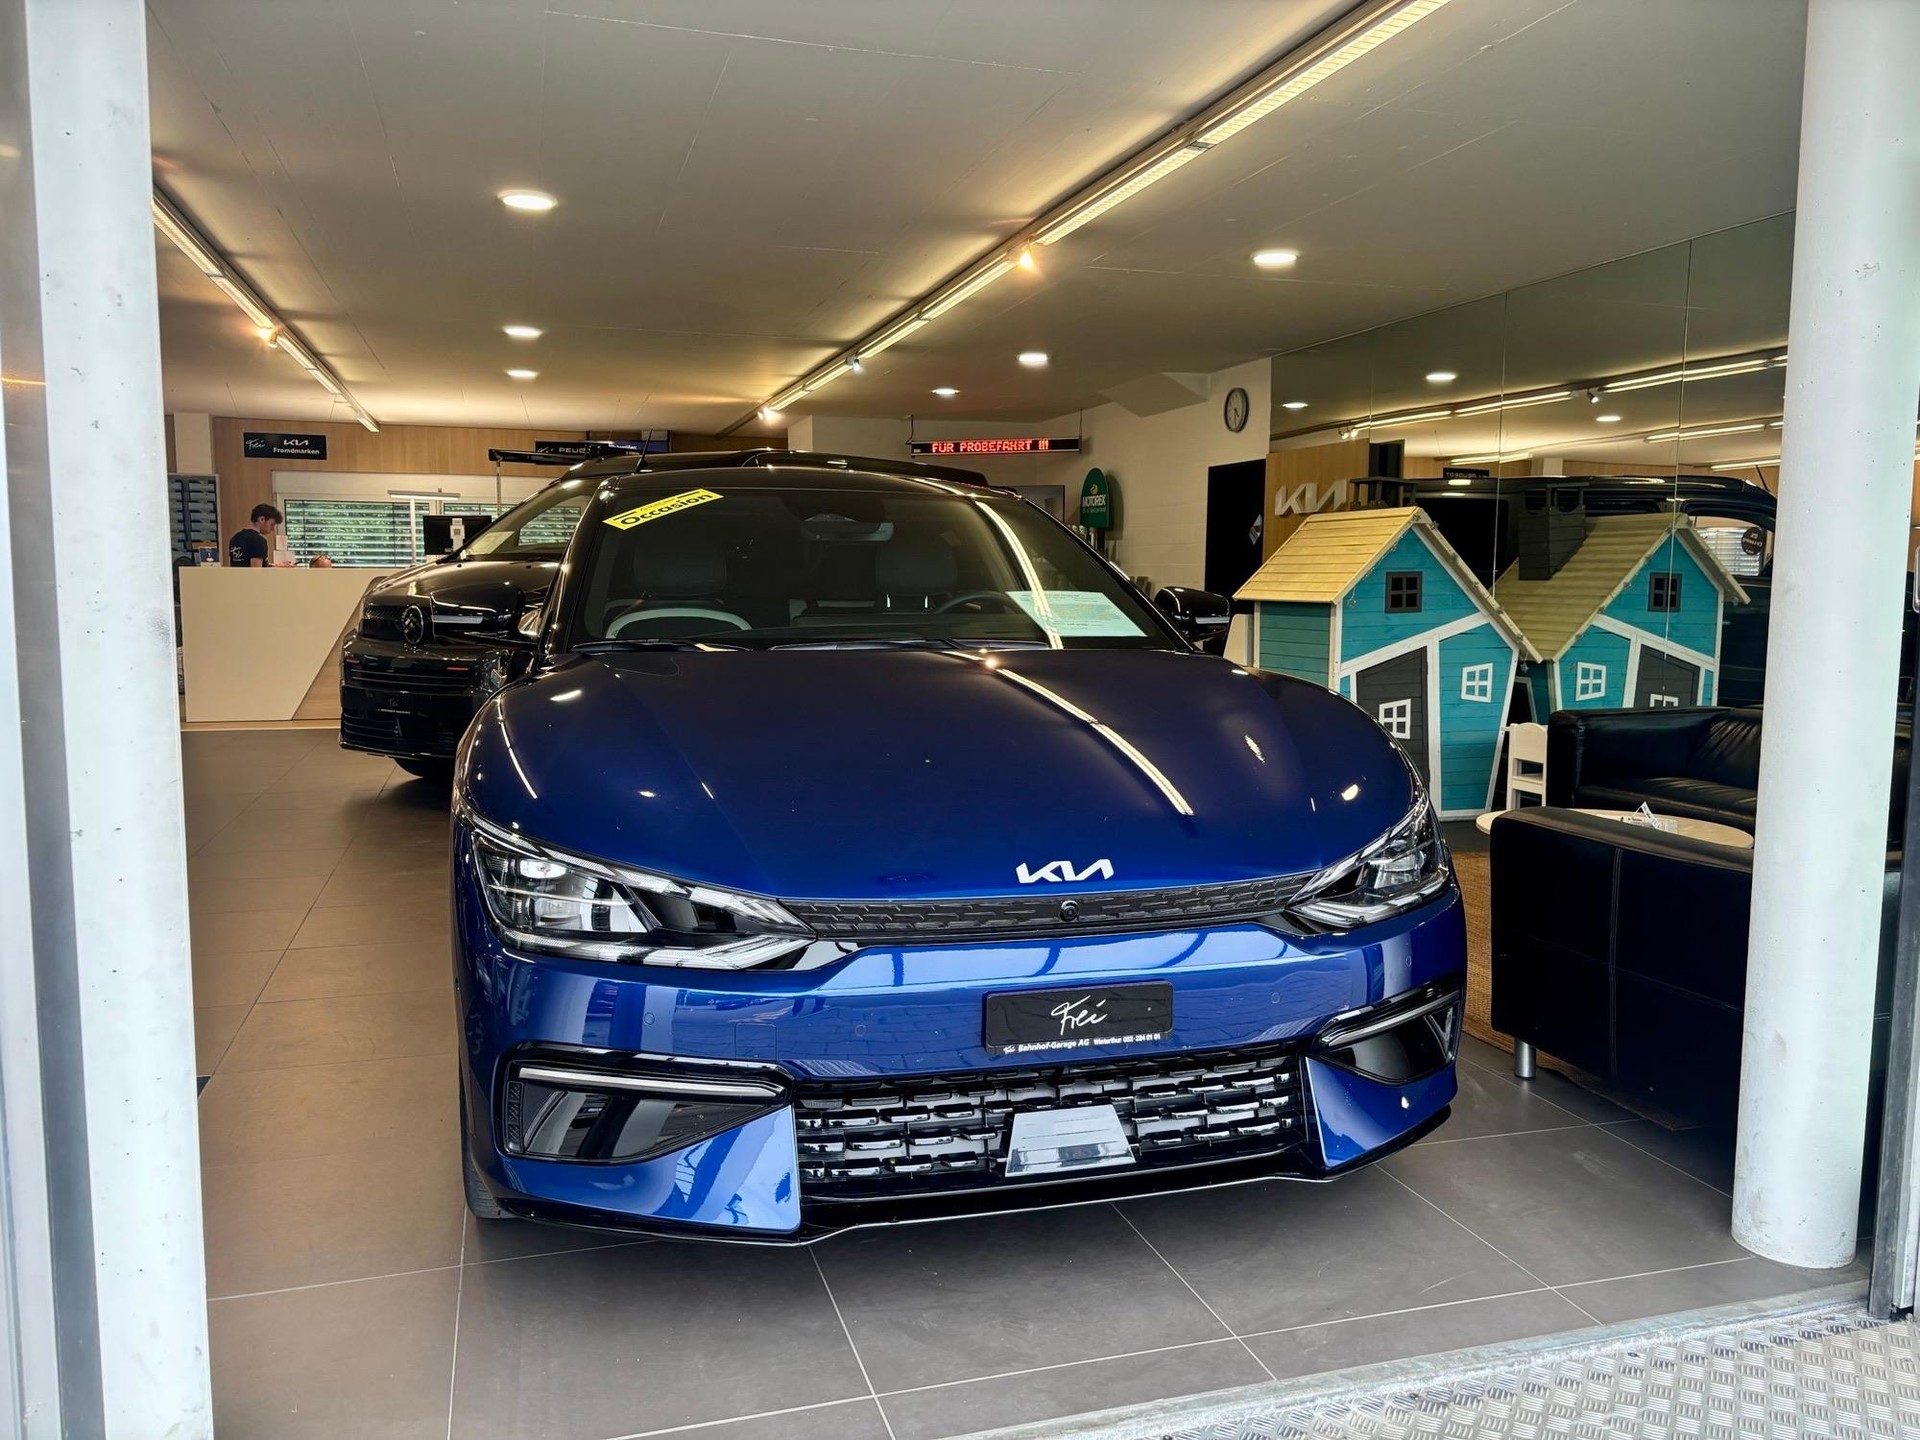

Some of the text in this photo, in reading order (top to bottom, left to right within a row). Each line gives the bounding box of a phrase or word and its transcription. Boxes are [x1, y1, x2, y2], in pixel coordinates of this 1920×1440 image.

[273, 447, 320, 455] Fremdmarken
[960, 439, 1033, 452] PROBEFAHRT
[1082, 494, 1107, 507] MOTOREX
[1275, 479, 1347, 515] KIA
[620, 494, 713, 525] Occasion
[1015, 858, 1115, 884] KIA
[1018, 1040, 1077, 1053] Bahnhof-Garage
[1077, 1038, 1090, 1047] AG
